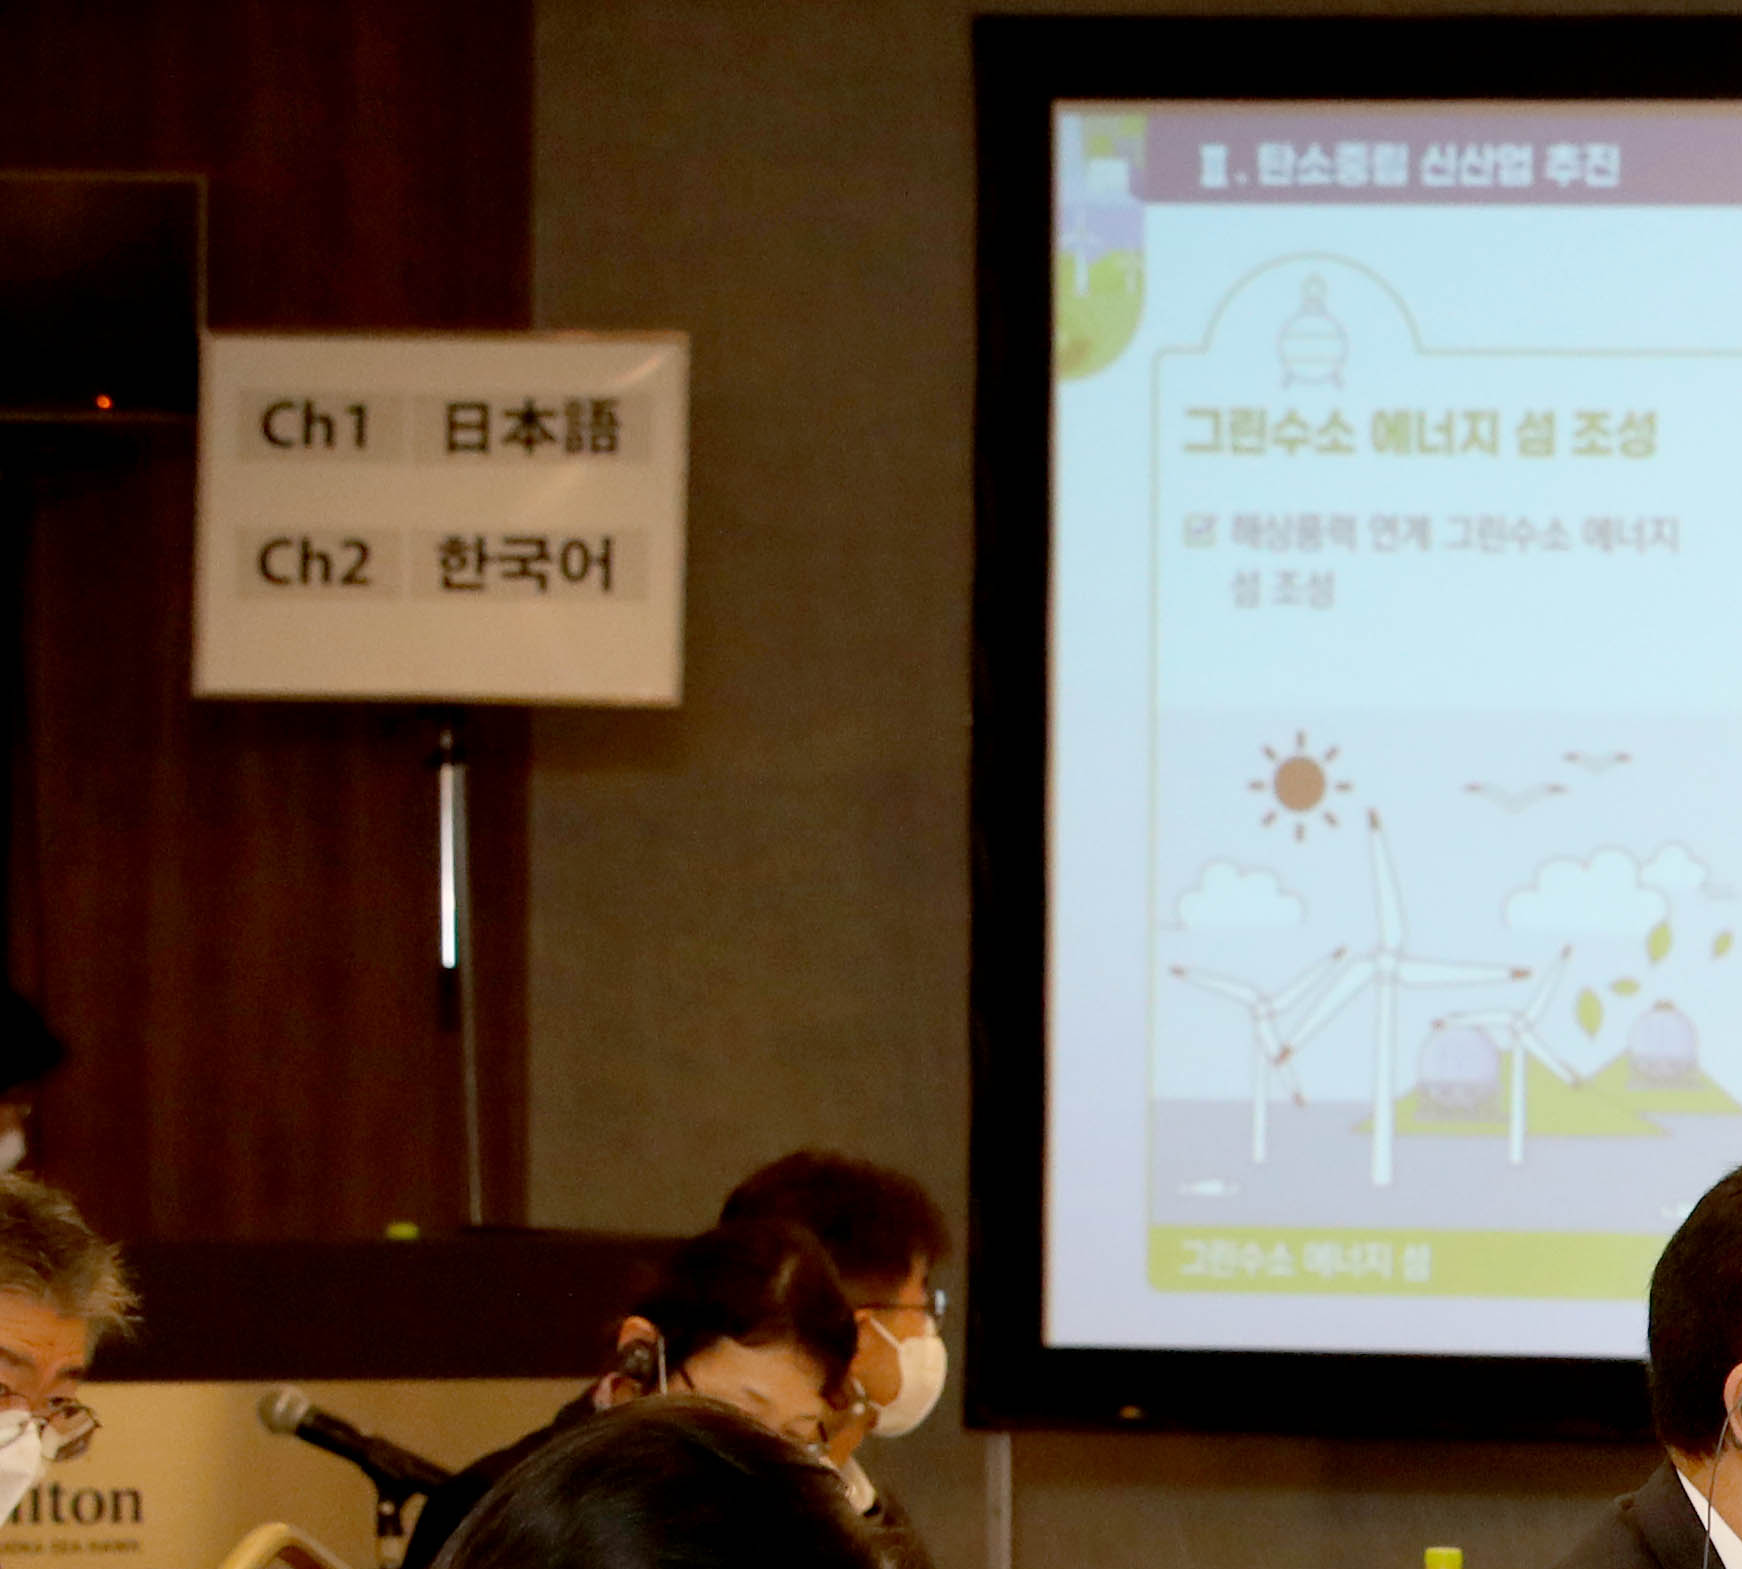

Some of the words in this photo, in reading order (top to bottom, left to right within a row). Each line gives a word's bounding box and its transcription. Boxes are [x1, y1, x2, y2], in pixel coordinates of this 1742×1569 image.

[1420, 143, 1533, 187] 신산업
[1546, 143, 1621, 187] 추진
[261, 400, 369, 451] Ch1
[446, 399, 621, 455] 日本語
[1183, 407, 1357, 458] 그린수소
[1371, 407, 1502, 458] 에너지
[1515, 408, 1558, 460] 섬
[1571, 408, 1660, 460] 조성
[1445, 515, 1572, 556] 그린수소
[1583, 514, 1681, 556] 에너지
[257, 540, 371, 586] Ch2
[436, 536, 615, 593] 한국어
